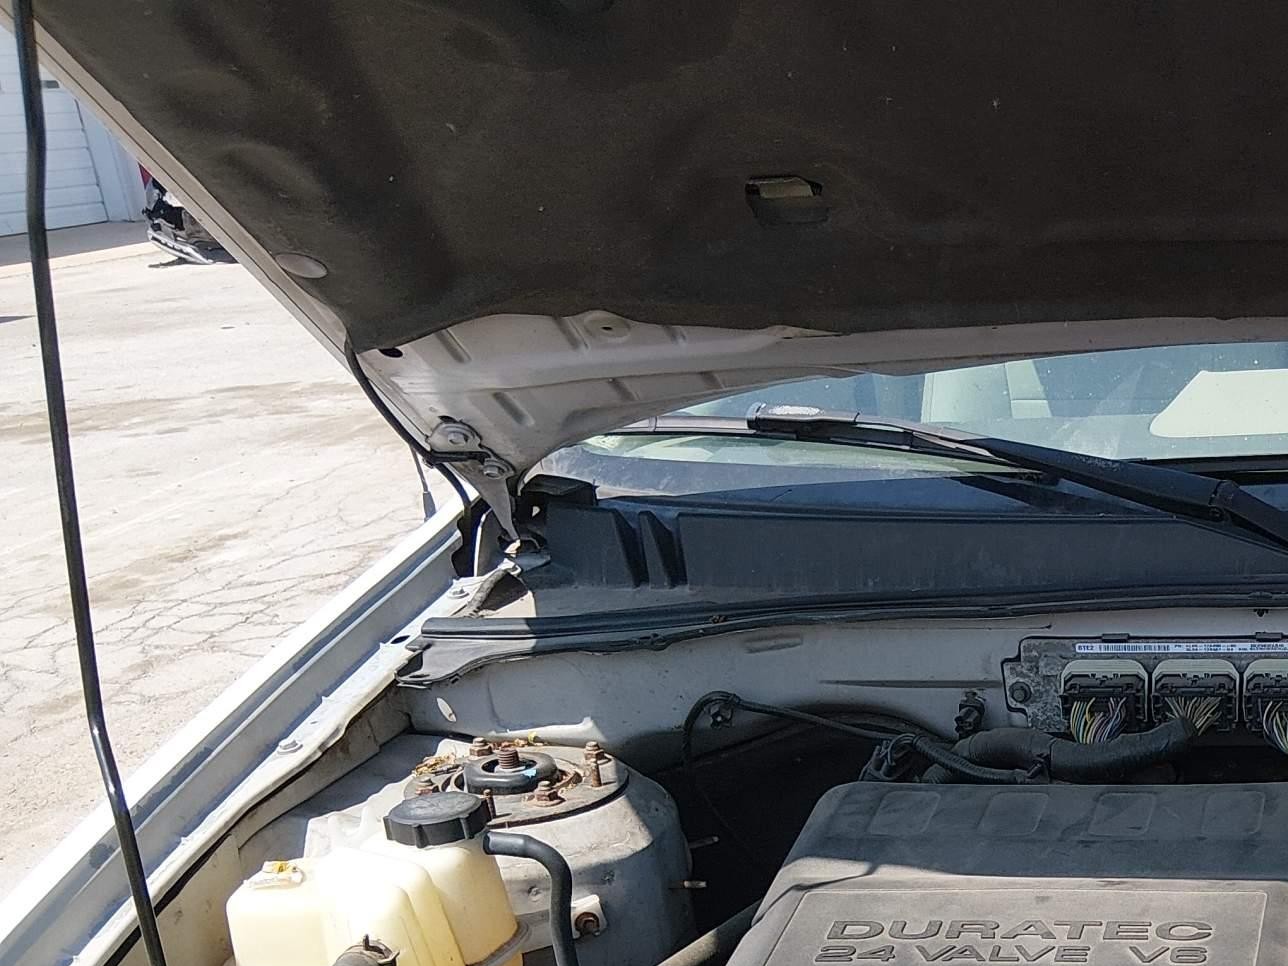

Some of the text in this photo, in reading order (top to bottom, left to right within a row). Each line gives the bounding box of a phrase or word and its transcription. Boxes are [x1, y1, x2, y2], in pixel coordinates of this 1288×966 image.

[826, 919, 1214, 942] DURATEC
[814, 944, 1209, 964] 24 VALVE V6
